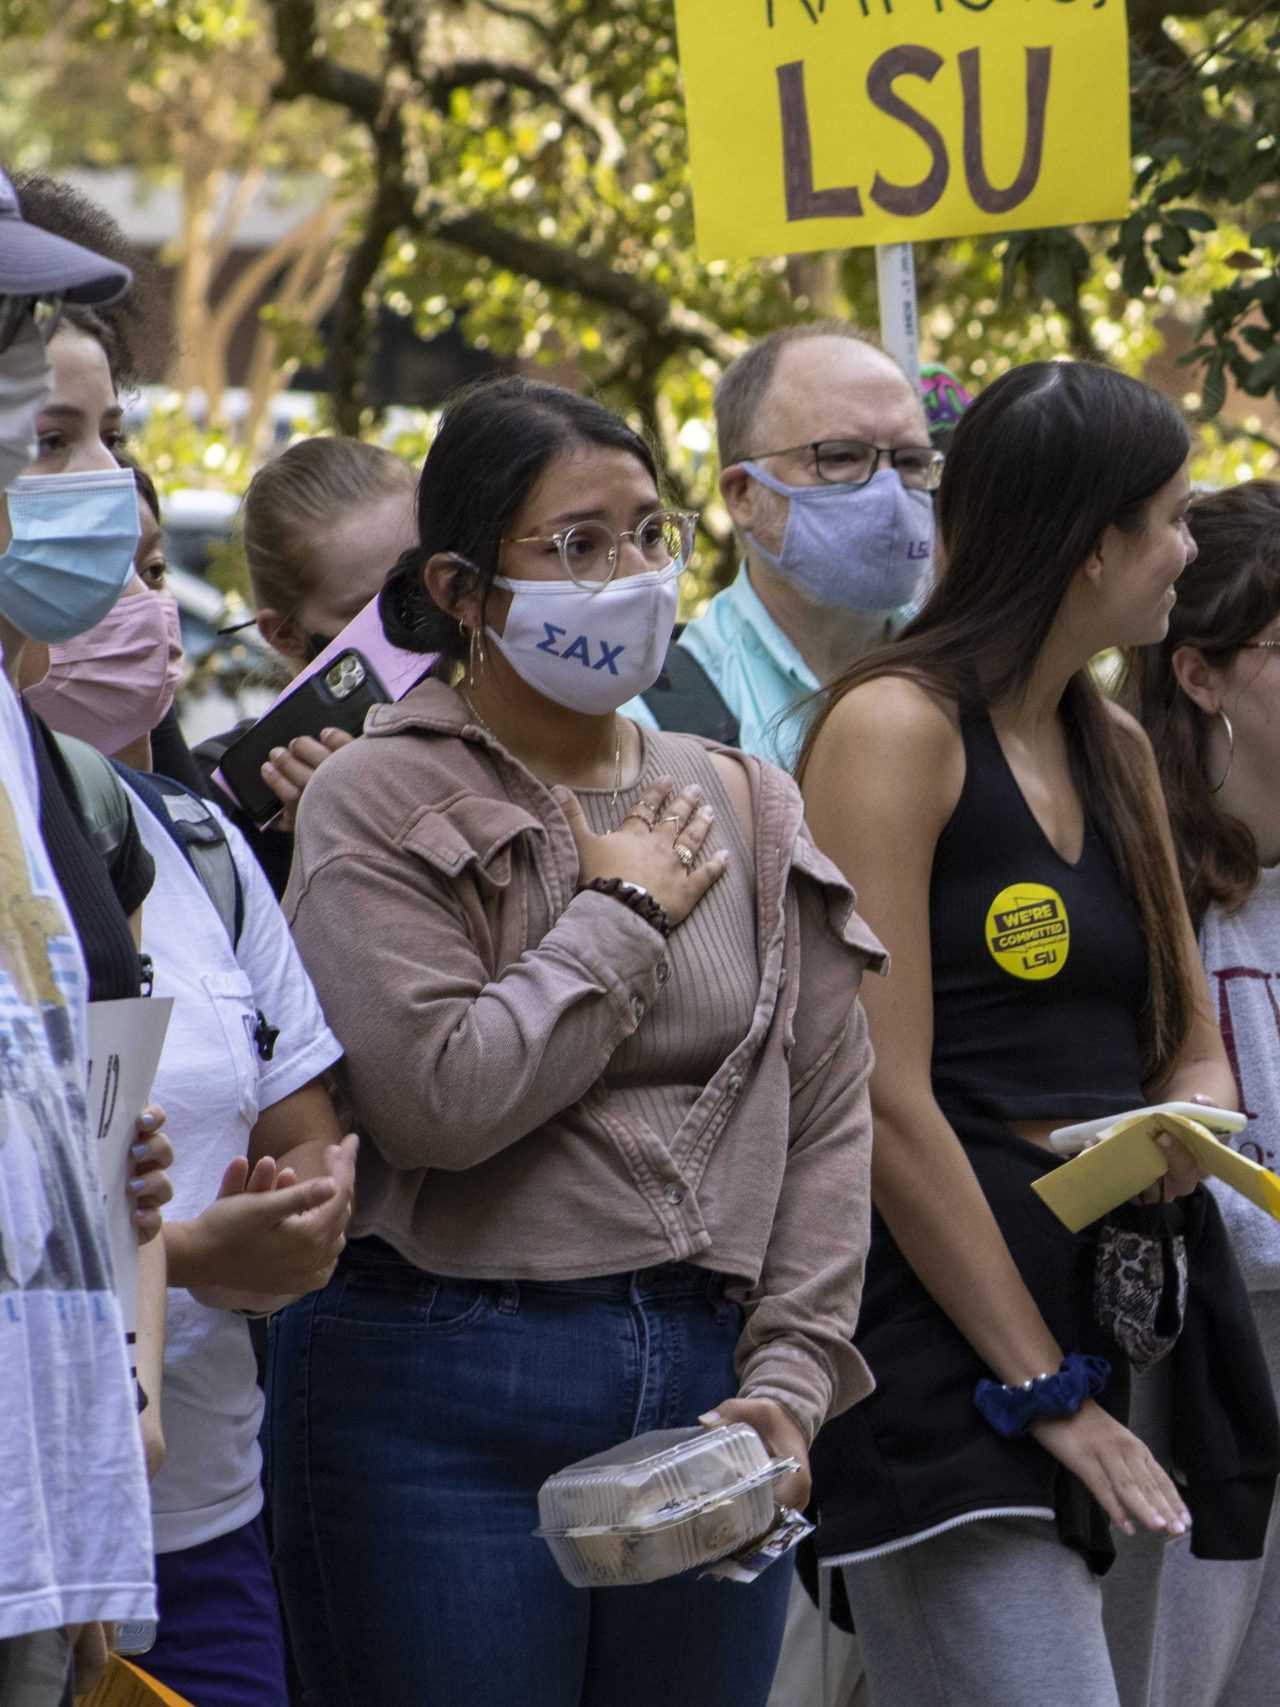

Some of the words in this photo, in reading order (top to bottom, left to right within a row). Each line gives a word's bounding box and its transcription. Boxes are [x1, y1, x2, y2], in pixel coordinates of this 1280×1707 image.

[776, 44, 1053, 222] LSU
[907, 541, 930, 560] LS
[1002, 903, 1053, 928] WE'RE
[999, 923, 1064, 948] COMMITTED
[1022, 949, 1057, 970] LSU
